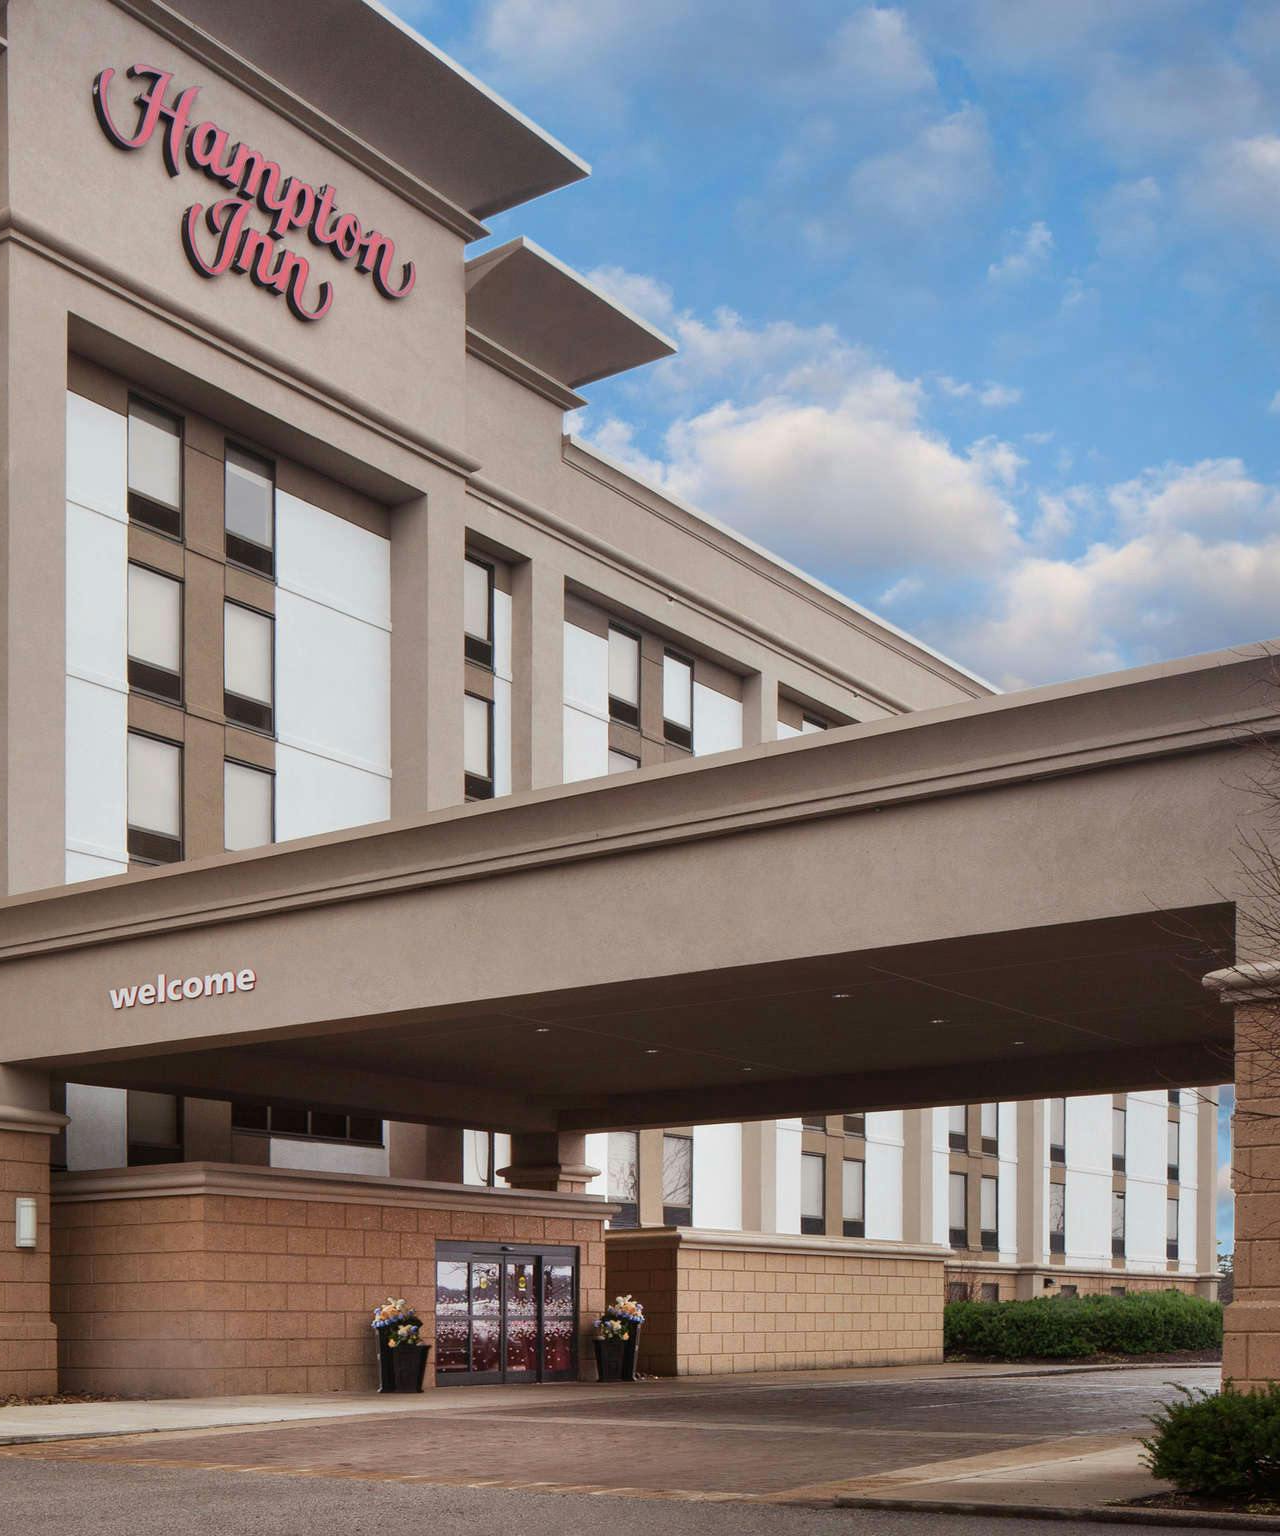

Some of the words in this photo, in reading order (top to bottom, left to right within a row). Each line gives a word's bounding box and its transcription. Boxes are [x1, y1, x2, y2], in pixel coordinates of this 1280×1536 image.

[92, 63, 417, 299] Hampton
[181, 198, 334, 322] Inn
[109, 968, 256, 1010] welcome
